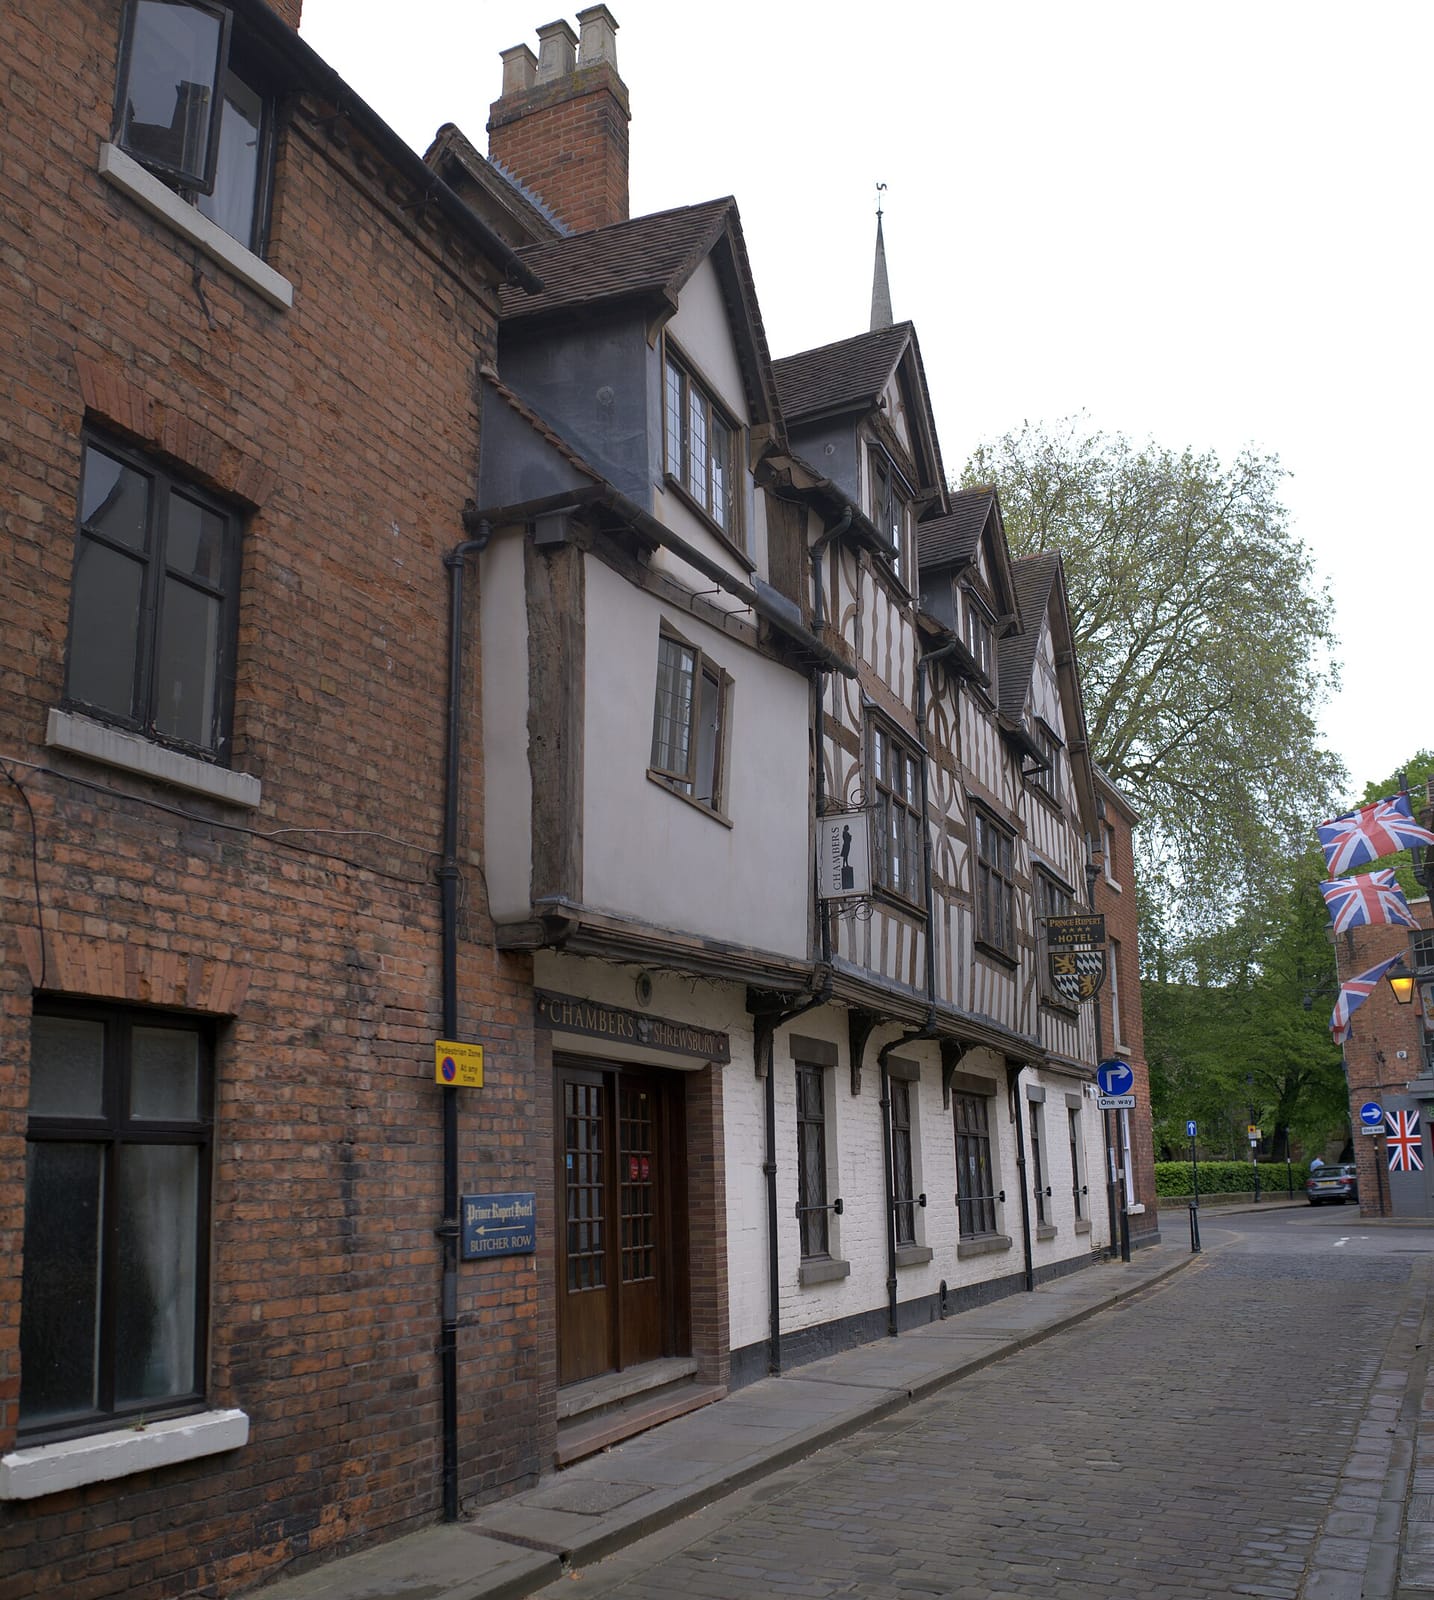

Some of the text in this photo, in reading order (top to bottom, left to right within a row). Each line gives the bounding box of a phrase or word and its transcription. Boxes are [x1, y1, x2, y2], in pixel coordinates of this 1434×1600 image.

[830, 826, 841, 891] CHAMBERS
[1050, 917, 1101, 928] PRINCE RUPERT
[1058, 933, 1093, 943] HOTEL
[550, 999, 715, 1054] CHAMBERS SHREWSBURY
[437, 1045, 481, 1058] Pedestrian Zone
[460, 1063, 478, 1075] At any
[463, 1073, 476, 1083] time
[1100, 1098, 1115, 1106] One
[466, 1199, 533, 1227] Prince Rupert Hotel
[470, 1234, 532, 1253] BUTCHER ROW
